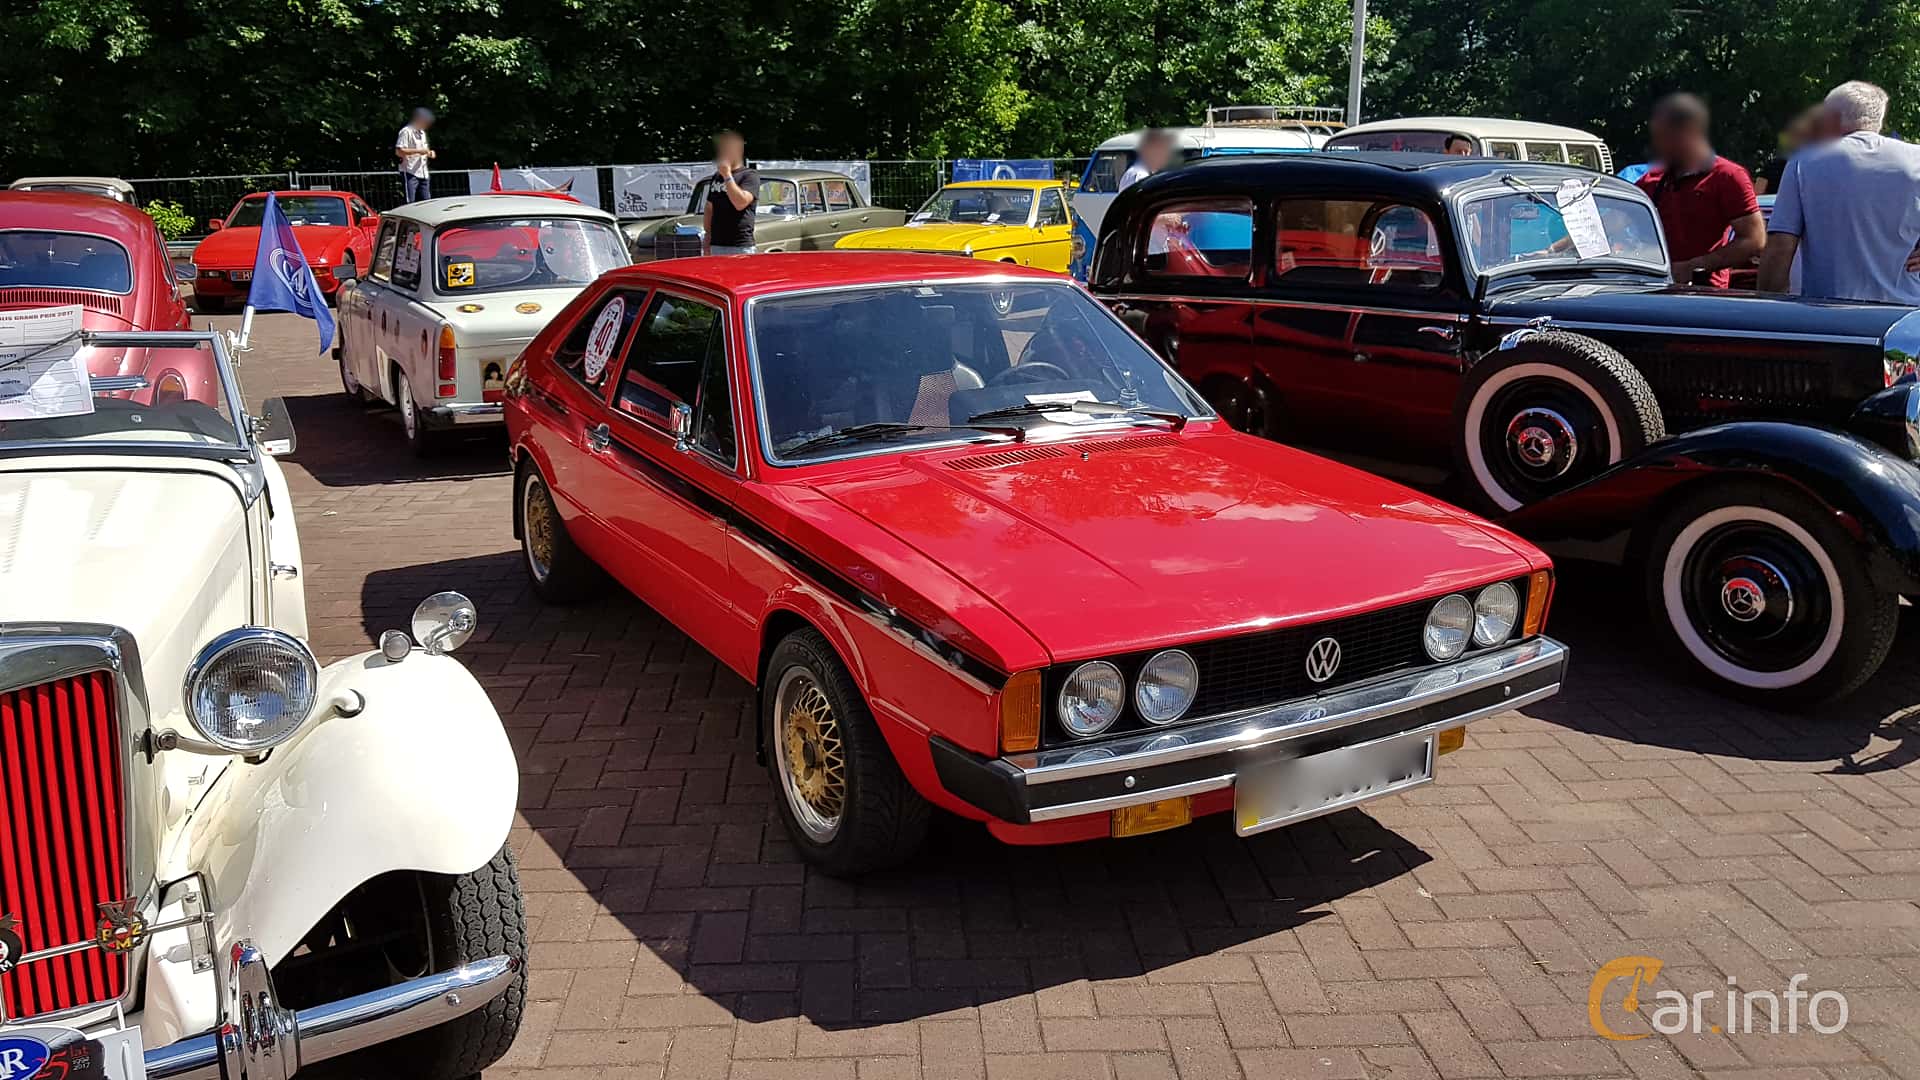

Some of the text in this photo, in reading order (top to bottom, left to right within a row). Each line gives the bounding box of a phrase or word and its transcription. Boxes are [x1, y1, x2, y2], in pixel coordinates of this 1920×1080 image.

[659, 183, 692, 191] ГОТЕЛЬ
[654, 192, 692, 201] РЕСТОРА
[594, 319, 614, 356] 40
